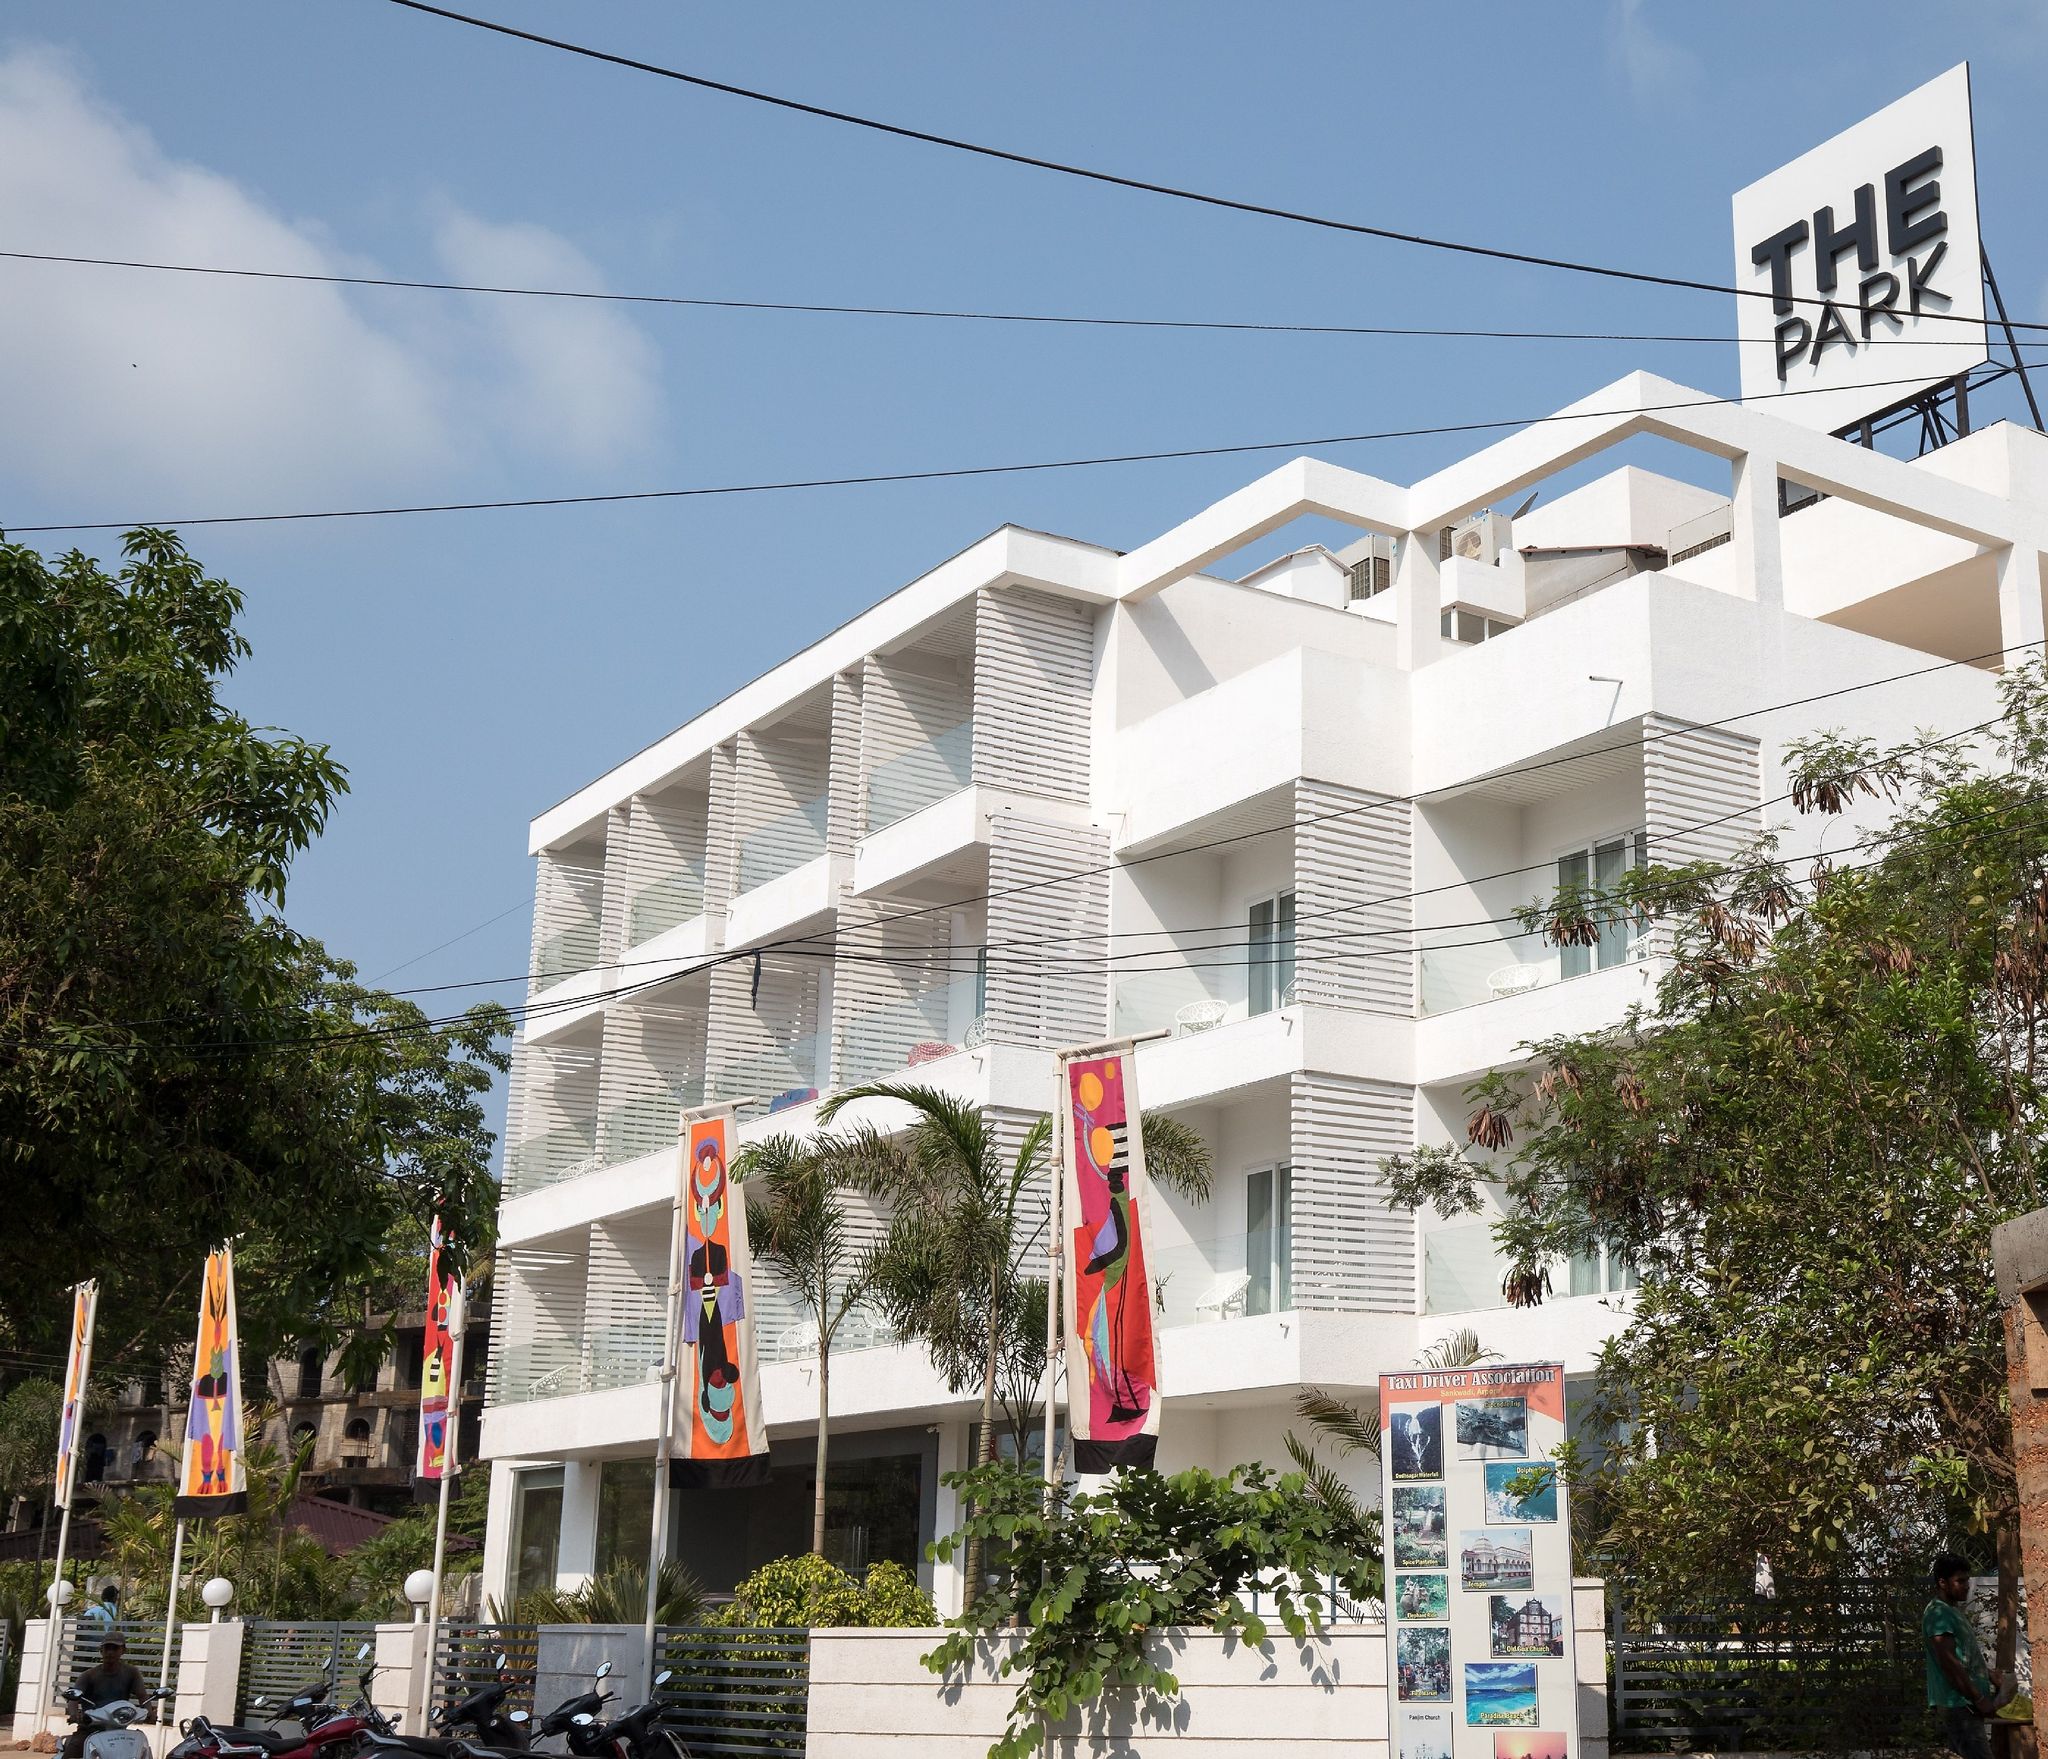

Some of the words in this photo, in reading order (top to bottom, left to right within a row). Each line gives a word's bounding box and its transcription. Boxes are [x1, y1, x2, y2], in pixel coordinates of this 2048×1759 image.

[1751, 145, 1948, 316] THE
[1774, 241, 1952, 382] PARK
[1387, 1374, 1418, 1391] Taxi
[1421, 1373, 1468, 1389] Driver
[1471, 1368, 1556, 1387] Association
